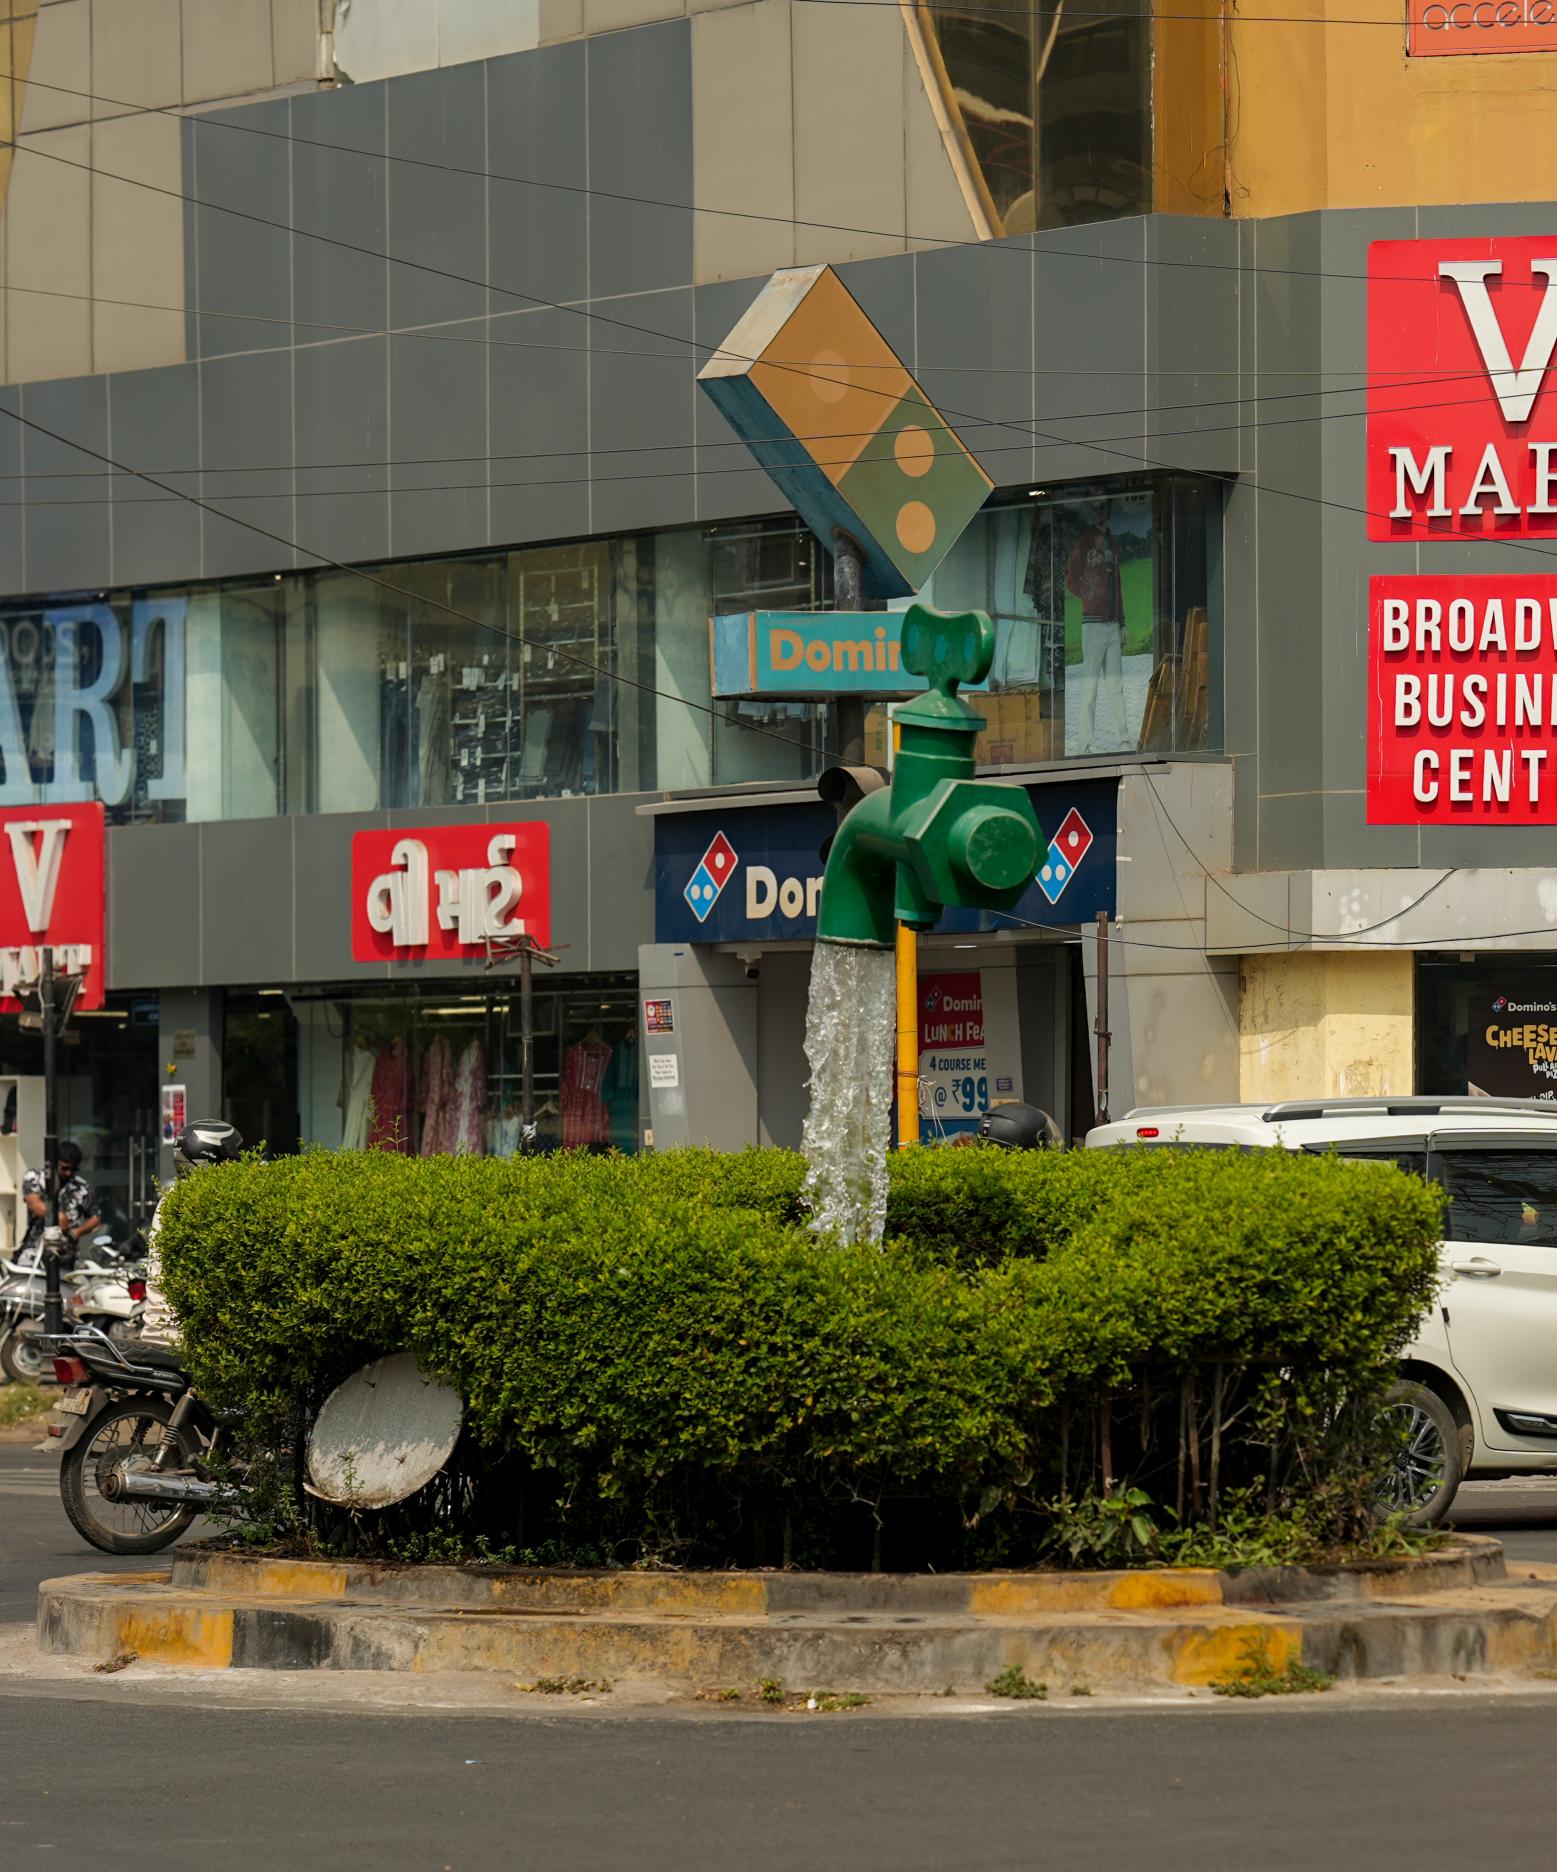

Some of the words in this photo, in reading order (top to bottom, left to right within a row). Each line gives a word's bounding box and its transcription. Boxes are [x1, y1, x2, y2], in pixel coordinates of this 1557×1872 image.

[4, 819, 73, 933] V
[1507, 1001, 1557, 1012] Domino's
[930, 1056, 937, 1072] 4
[938, 1058, 971, 1071] COURSE
